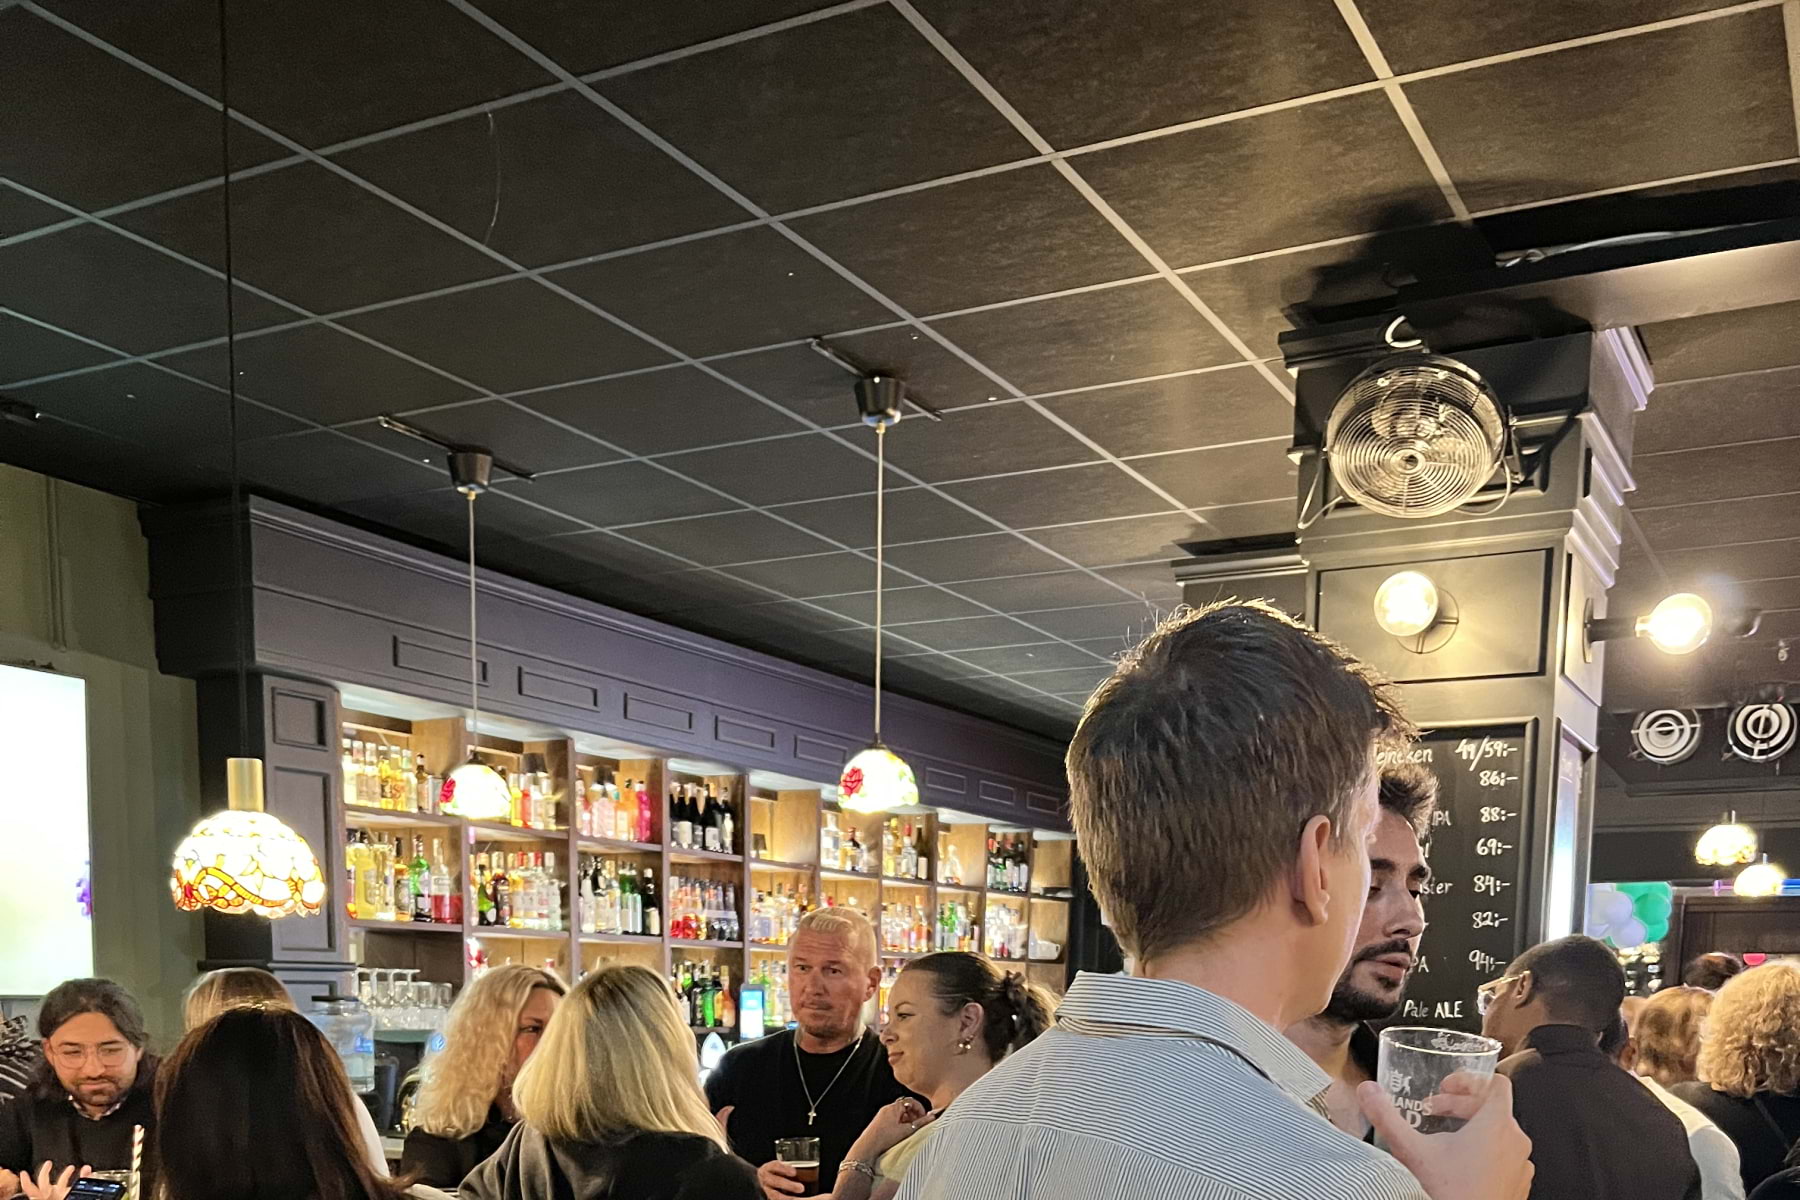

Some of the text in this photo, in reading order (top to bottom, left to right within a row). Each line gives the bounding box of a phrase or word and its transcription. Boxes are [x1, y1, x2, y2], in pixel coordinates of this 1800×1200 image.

[1479, 770, 1519, 787] 86:-
[1480, 806, 1517, 823] 88:-
[1476, 837, 1513, 856] 69:-
[1473, 874, 1511, 896] 84:-
[1471, 911, 1509, 929] 82:-
[1402, 999, 1463, 1019] Pale ALE
